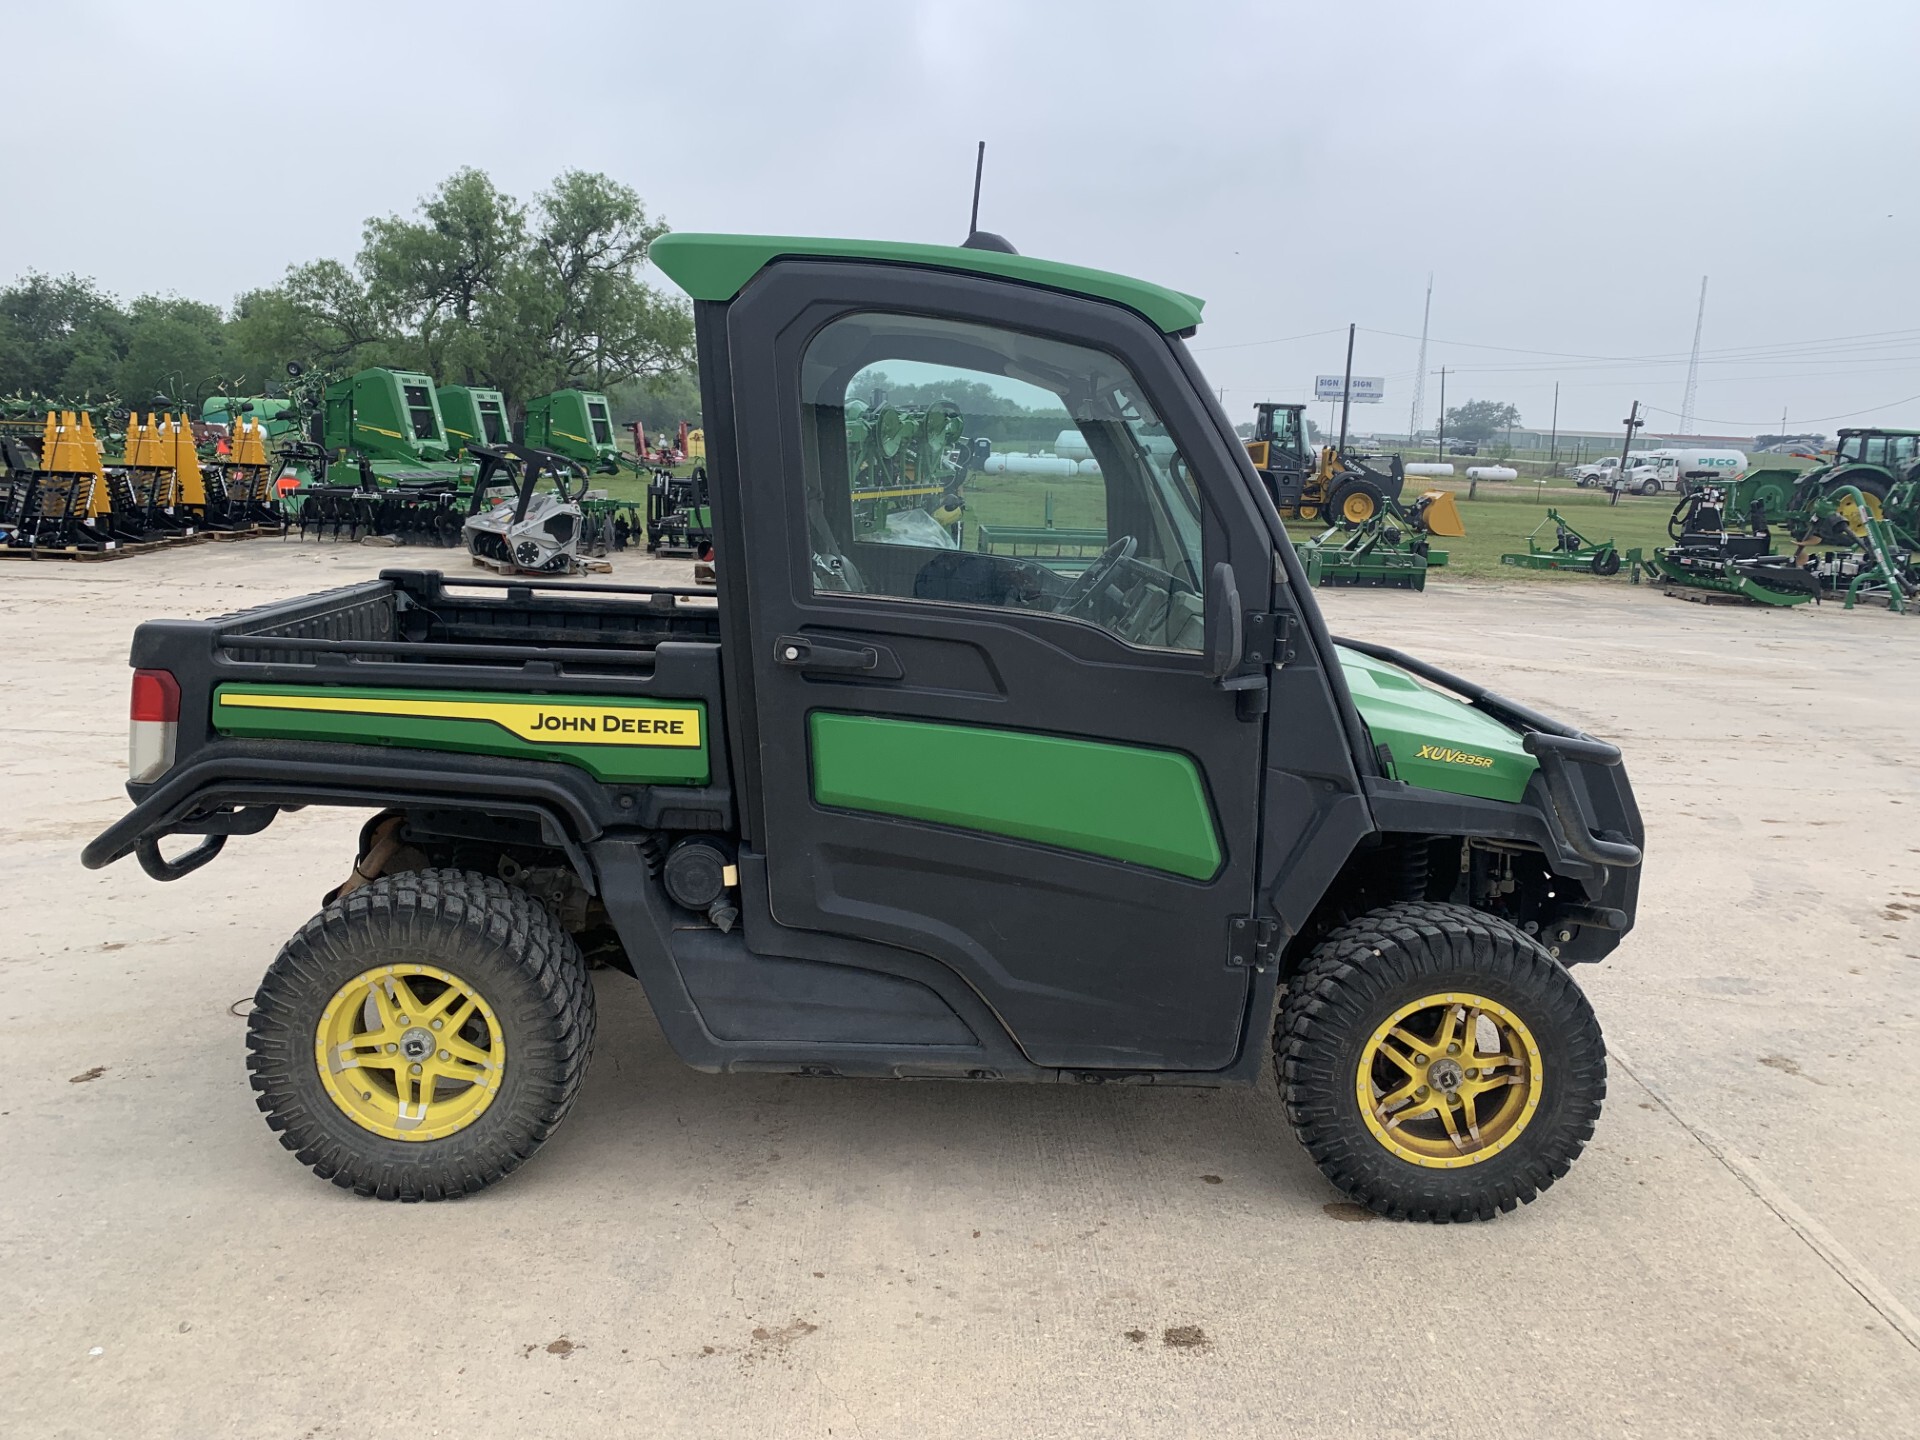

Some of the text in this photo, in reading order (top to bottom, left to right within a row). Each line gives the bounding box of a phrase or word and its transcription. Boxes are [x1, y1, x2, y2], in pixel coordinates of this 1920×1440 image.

[1319, 379, 1339, 387] SIGN
[1352, 380, 1372, 388] SIGN
[1344, 459, 1366, 476] DEERE
[530, 713, 684, 734] JOHN DEERE
[1414, 744, 1493, 768] XUV835R
